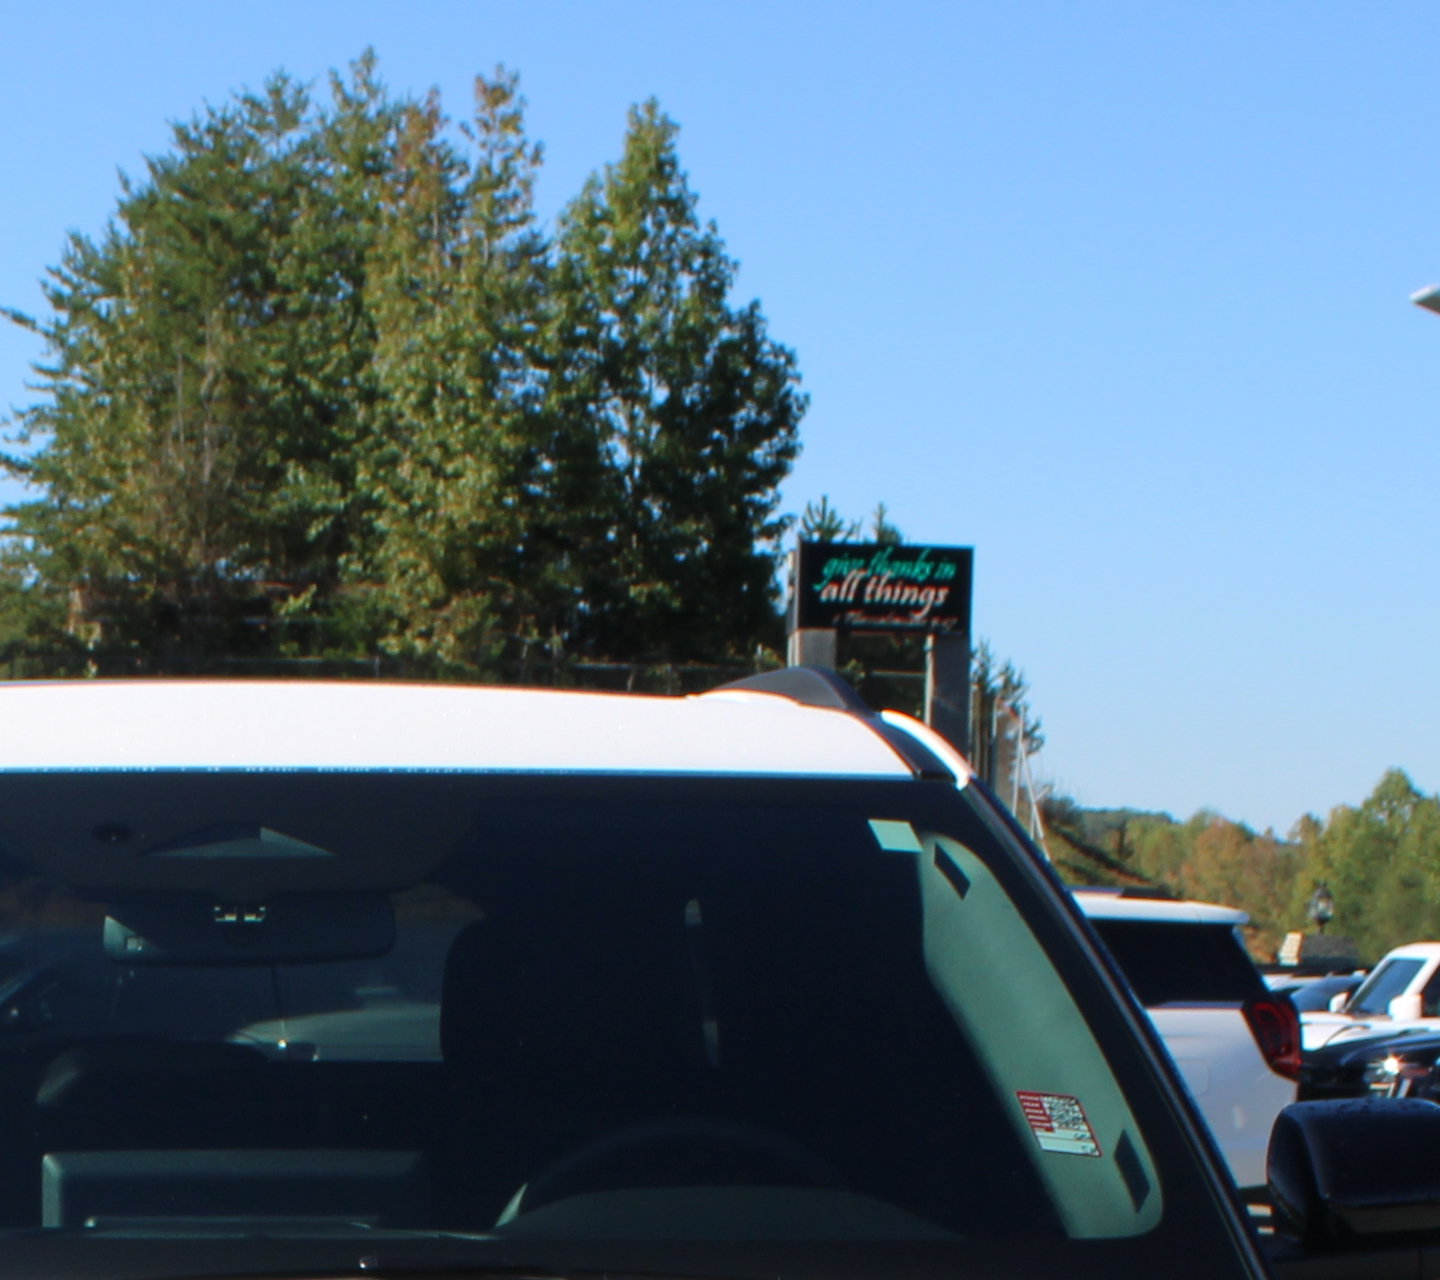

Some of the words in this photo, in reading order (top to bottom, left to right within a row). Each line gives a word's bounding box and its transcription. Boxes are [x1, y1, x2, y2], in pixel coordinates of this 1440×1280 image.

[812, 552, 866, 591] give
[866, 546, 935, 582] thanks
[934, 557, 957, 581] in
[819, 568, 869, 603] all
[864, 569, 951, 620] things
